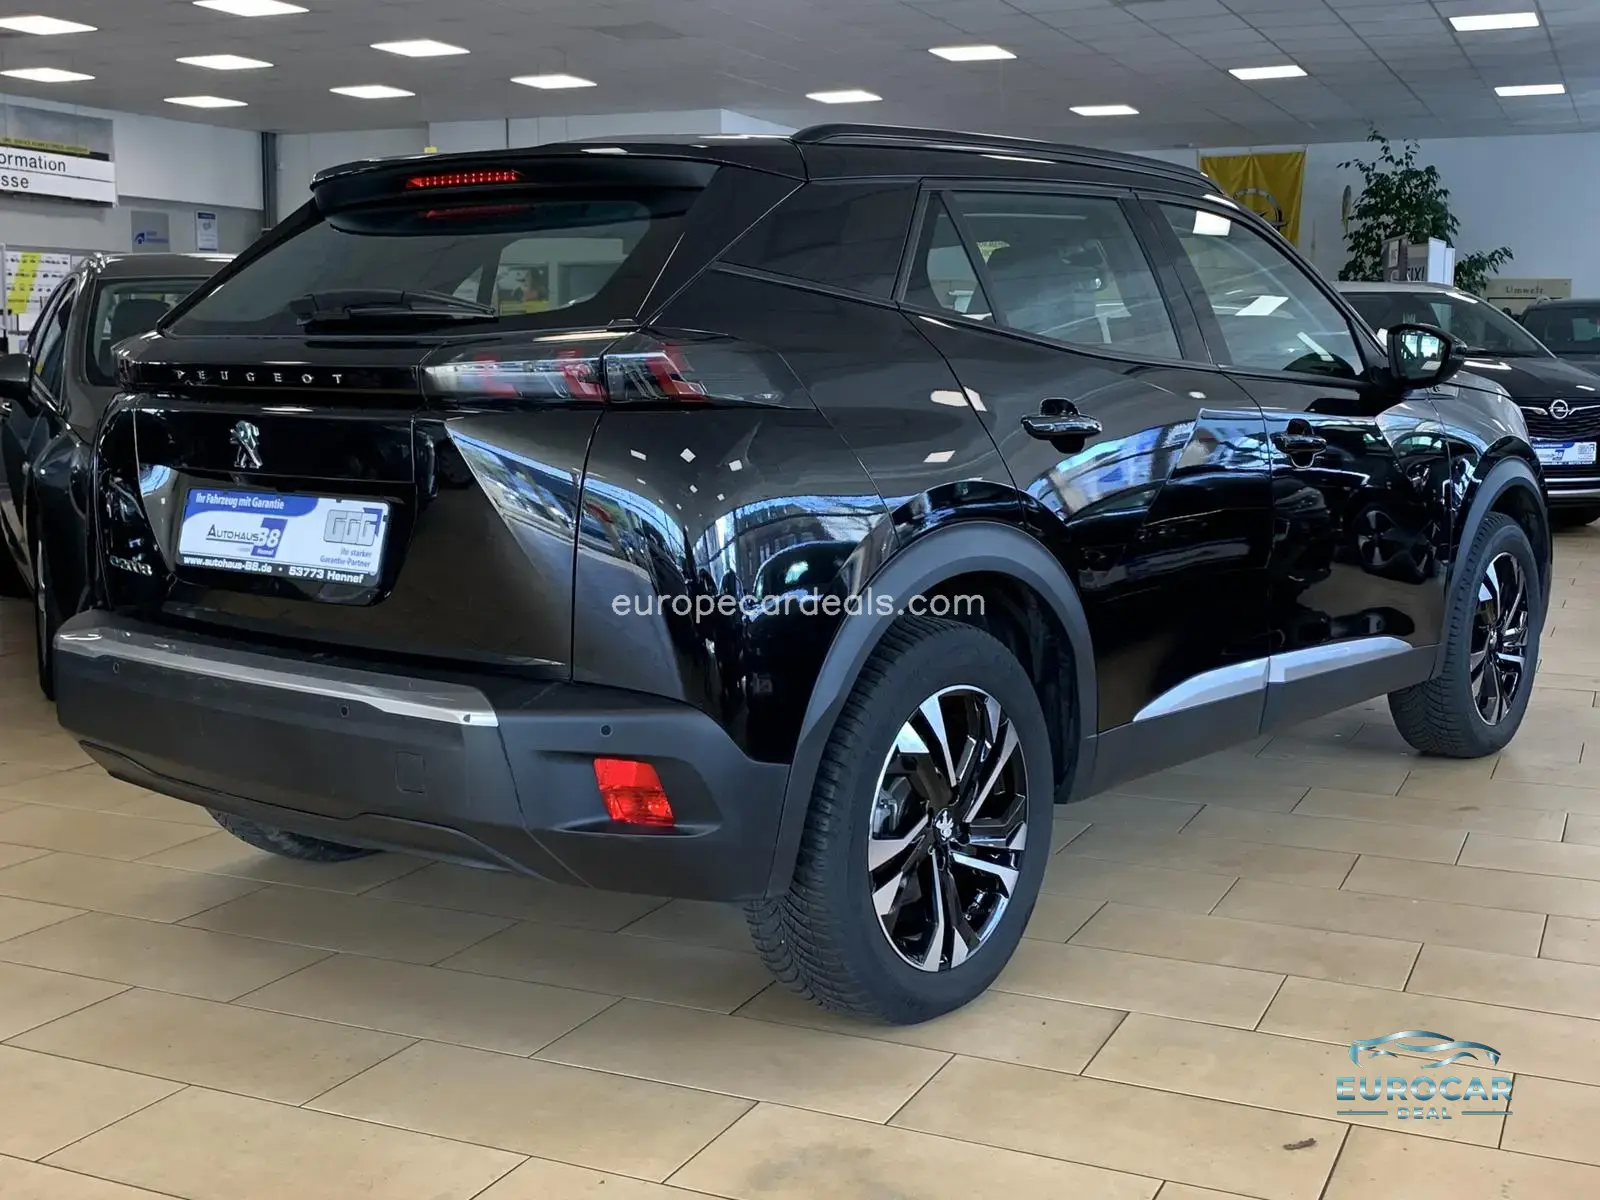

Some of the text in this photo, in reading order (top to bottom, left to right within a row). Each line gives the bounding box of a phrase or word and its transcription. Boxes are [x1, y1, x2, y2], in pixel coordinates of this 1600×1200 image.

[1, 175, 29, 188] sse
[174, 369, 343, 384] PEUGEOT
[195, 492, 285, 509] Ihr Fahrzeug mit Garantie
[288, 566, 325, 579] 53773
[326, 570, 364, 583] Hennef
